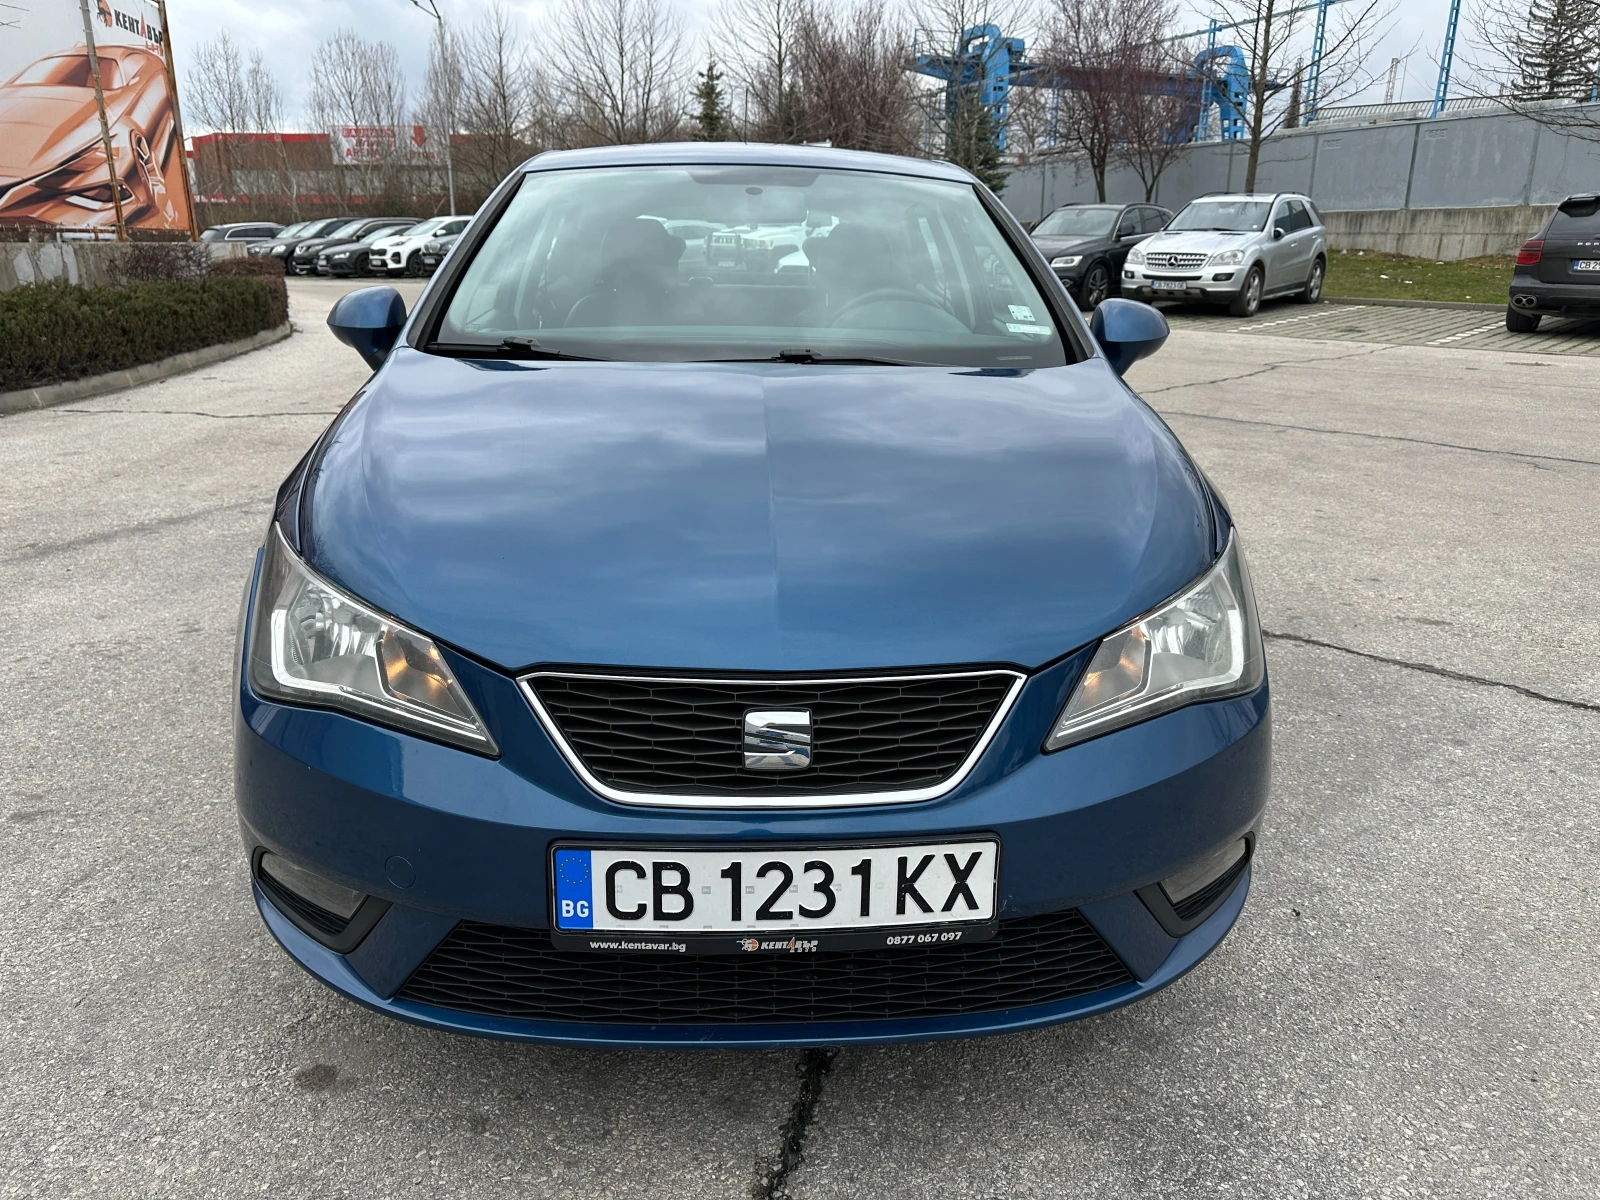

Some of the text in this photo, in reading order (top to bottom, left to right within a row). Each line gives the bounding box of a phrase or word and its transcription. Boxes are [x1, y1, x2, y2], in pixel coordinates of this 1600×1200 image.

[114, 9, 163, 46] КЕНТАВЪР
[606, 851, 982, 921] CB 1231 KX
[561, 900, 589, 917] BG
[761, 936, 818, 949] КЕНТАВЪР
[886, 931, 962, 945] 0877 067 097
[589, 941, 686, 952] www.kentavar.bg
